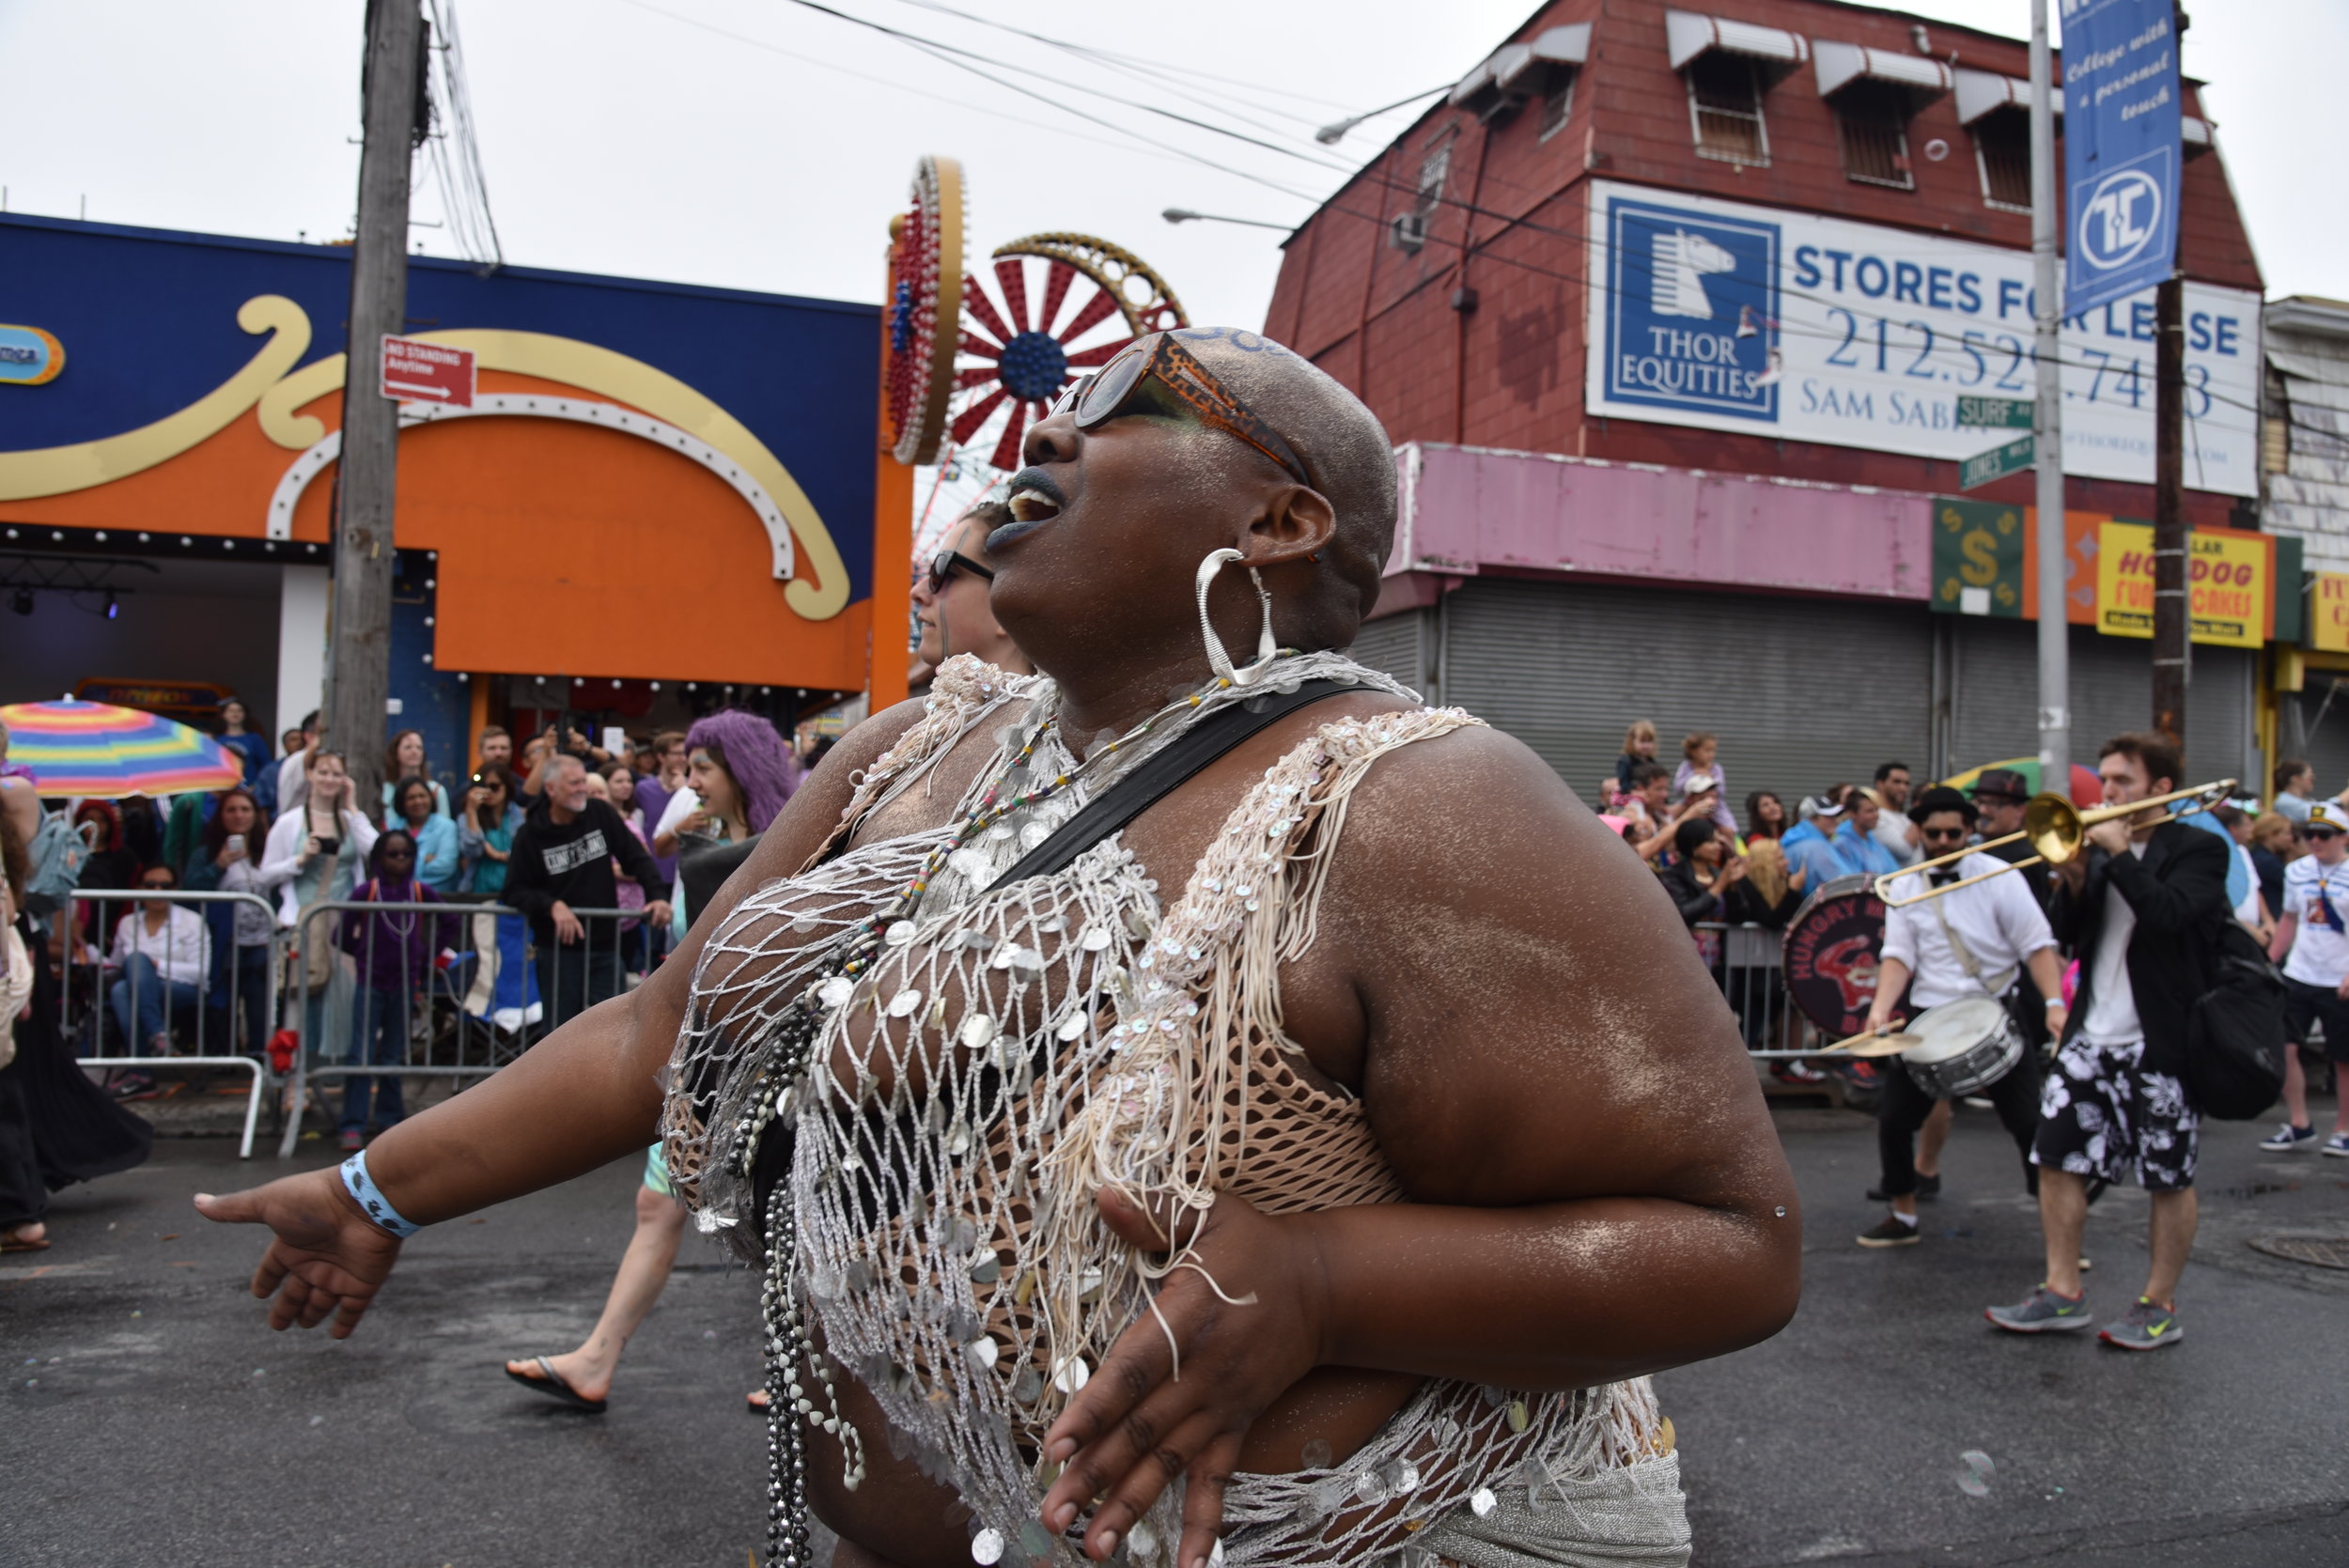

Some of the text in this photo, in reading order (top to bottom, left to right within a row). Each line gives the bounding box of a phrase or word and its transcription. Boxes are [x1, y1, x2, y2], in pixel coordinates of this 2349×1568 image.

[2066, 16, 2168, 84] College with
[2095, 50, 2170, 107] personal
[2121, 84, 2170, 121] touch
[1794, 245, 1982, 314] STORES
[2105, 301, 2239, 356] LESE
[387, 342, 460, 365] NO STANDING
[387, 356, 435, 375] Anytime
[1648, 325, 1740, 366] THOR
[1825, 306, 2211, 420] 212.52.743
[1622, 353, 1761, 399] EQUITIES
[1799, 378, 1874, 420] SAM
[1960, 398, 2013, 425] SURF
[1964, 451, 2002, 484] JONES
[2119, 551, 2253, 586] HO DOG
[2190, 587, 2252, 619] CAKES
[1791, 898, 1857, 981] HUNGRY
